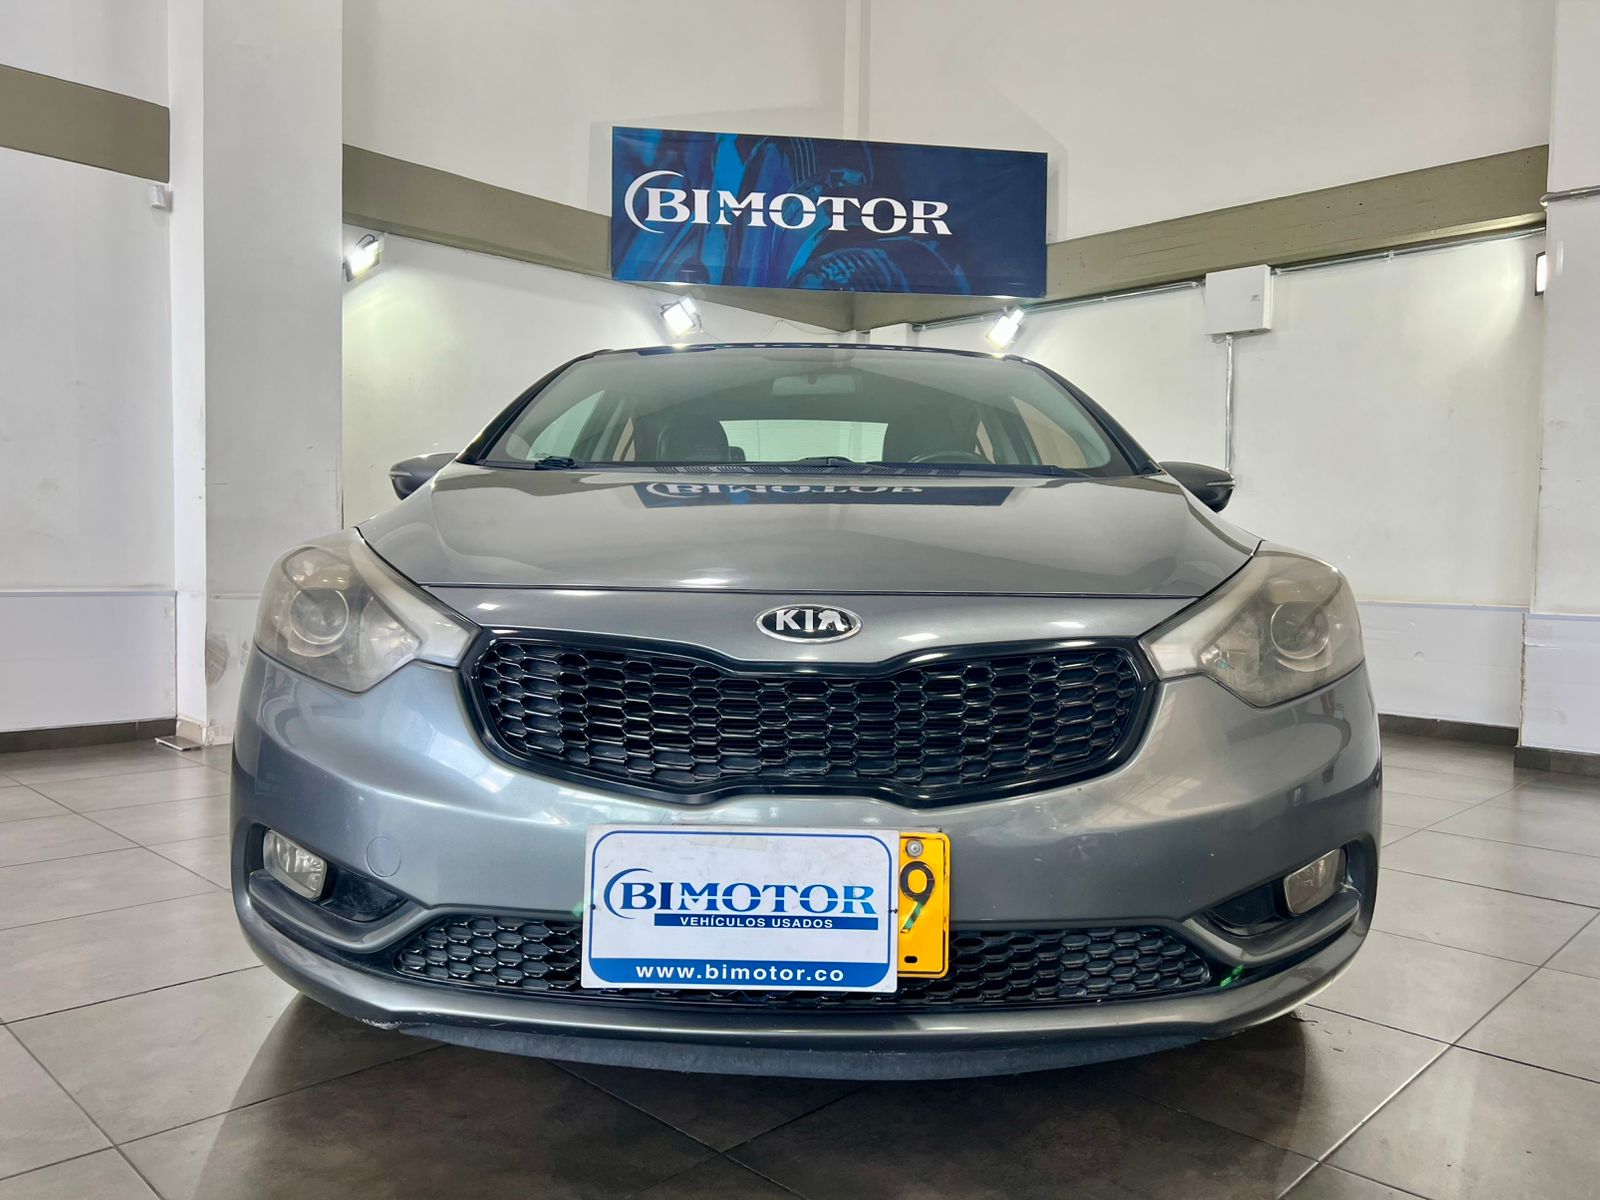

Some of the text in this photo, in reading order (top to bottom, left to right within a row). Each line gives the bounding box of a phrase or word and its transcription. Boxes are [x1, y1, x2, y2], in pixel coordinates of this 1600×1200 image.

[645, 187, 952, 236] BIMOTOR
[775, 609, 845, 632] KIA
[620, 881, 877, 915] BIMOTOR
[680, 915, 834, 929] VEHÍCULOS USADOS
[636, 964, 844, 982] www.bimotor.co
